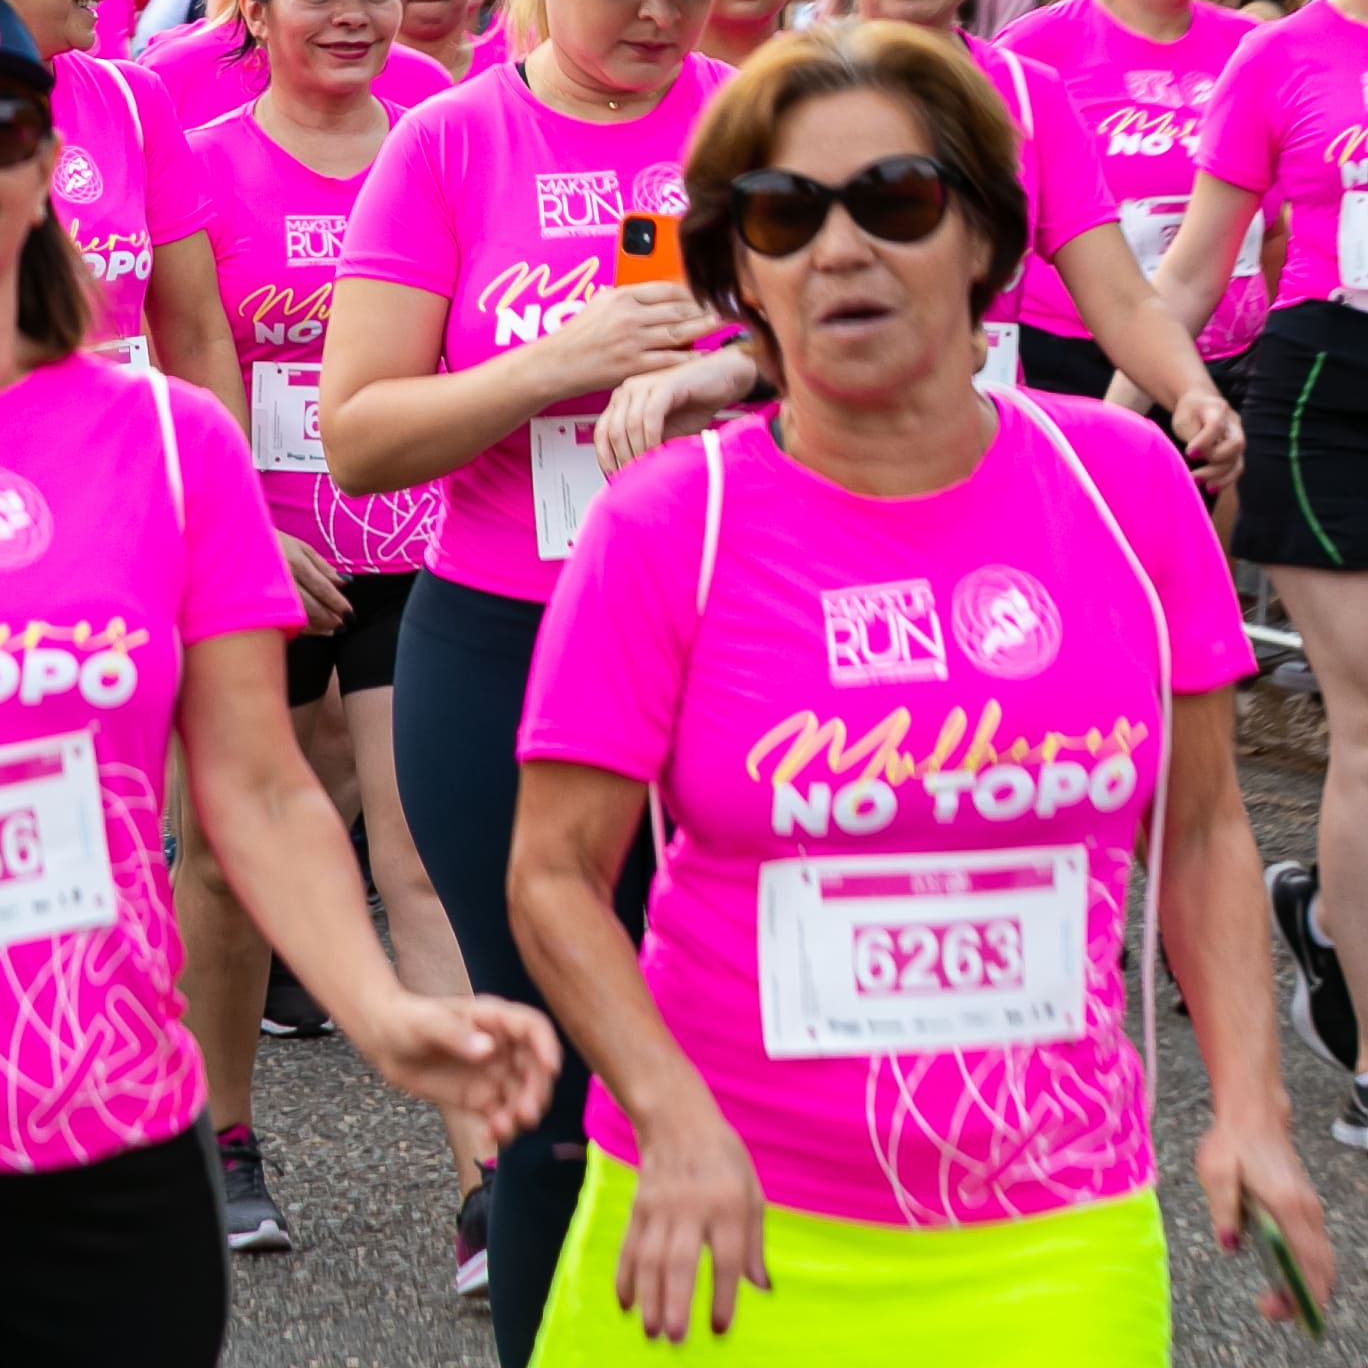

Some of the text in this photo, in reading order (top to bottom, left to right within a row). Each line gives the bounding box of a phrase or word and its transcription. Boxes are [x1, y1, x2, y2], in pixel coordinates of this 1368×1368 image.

[537, 176, 619, 196] MAKEUP
[287, 219, 346, 233] MAKEUP
[539, 190, 625, 226] RUN
[82, 249, 152, 281] OPO
[255, 320, 323, 345] NO
[824, 587, 936, 625] MAKEUP
[828, 609, 946, 670] RUN
[746, 697, 1149, 785] Mulheres
[772, 753, 1137, 838] NO TOPO
[855, 918, 1022, 990] 6263
